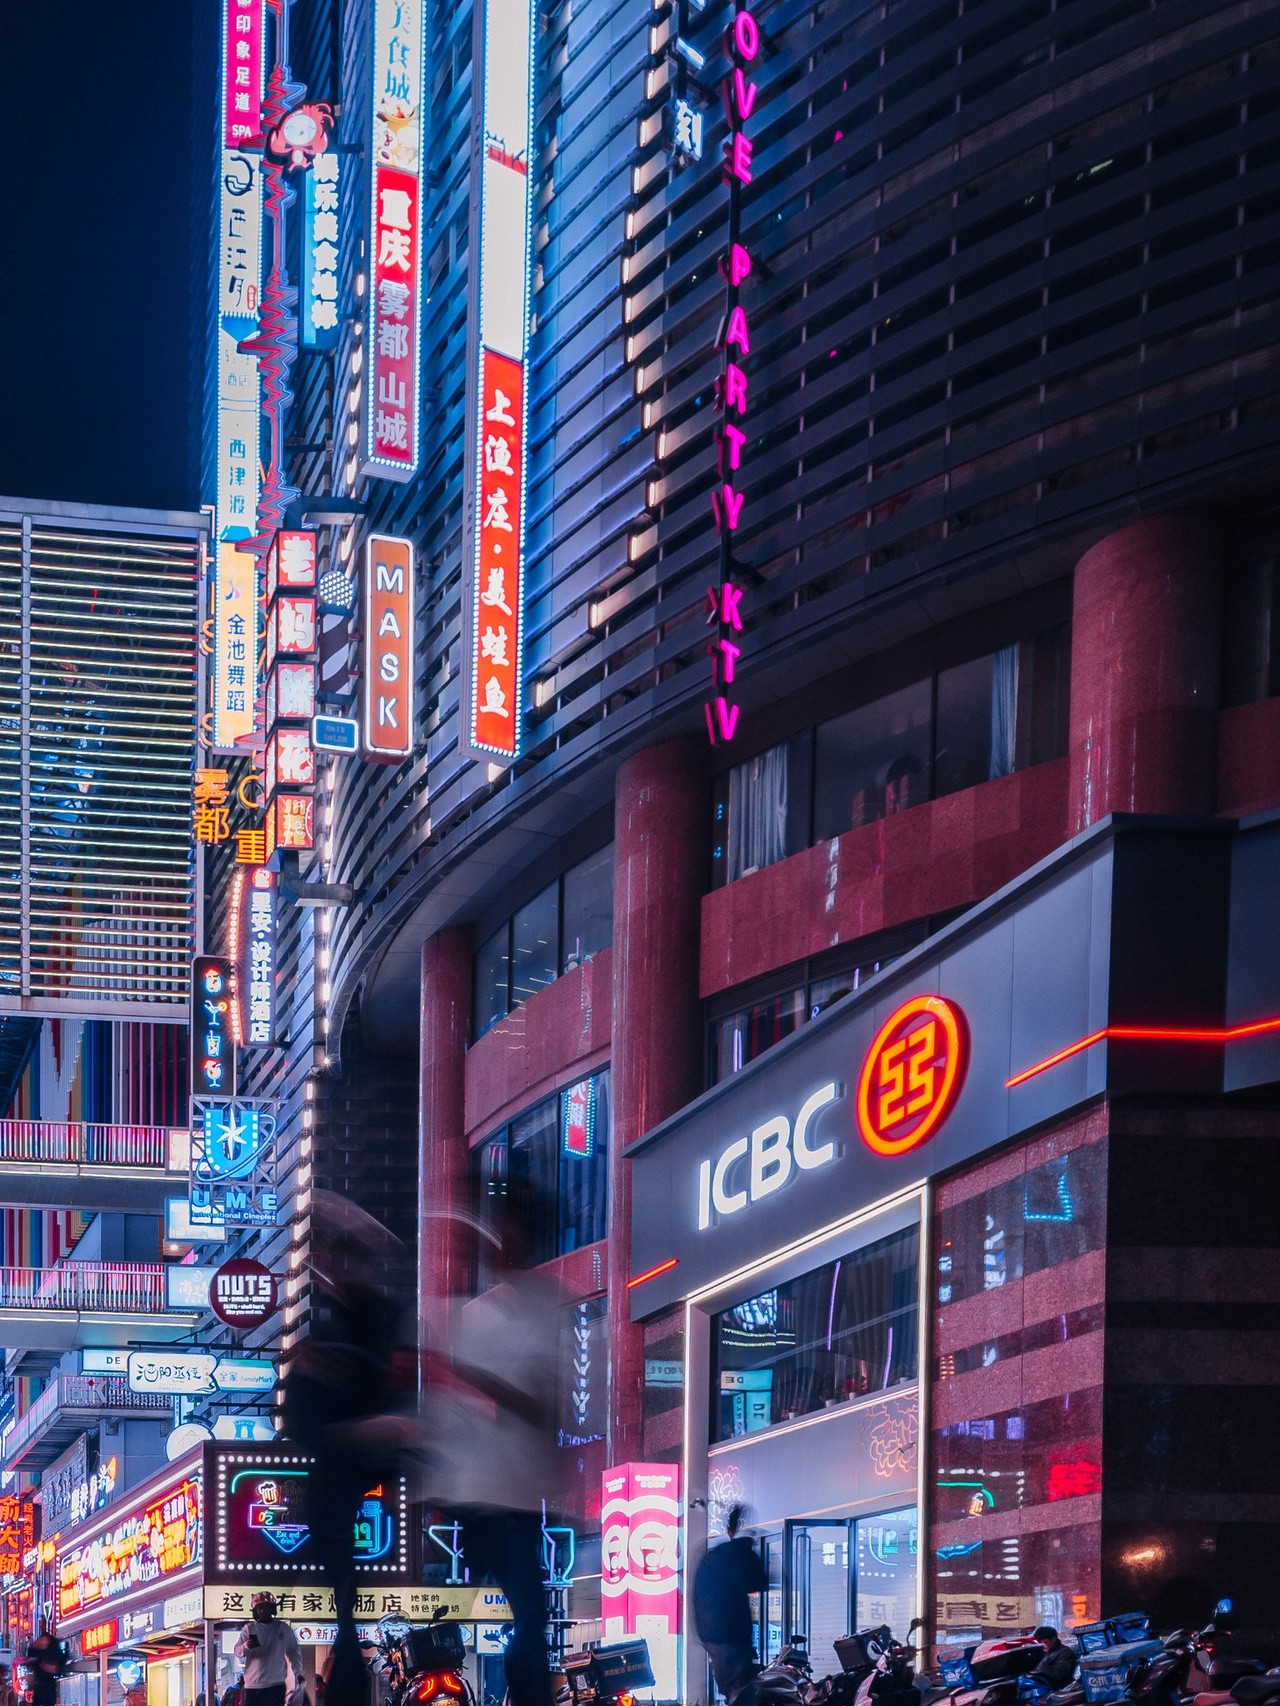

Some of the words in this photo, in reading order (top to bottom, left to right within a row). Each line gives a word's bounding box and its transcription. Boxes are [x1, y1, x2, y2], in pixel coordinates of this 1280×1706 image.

[733, 0, 759, 184] OVE
[232, 124, 252, 138] SPA
[723, 243, 751, 530] PARTY
[229, 438, 247, 514] 西津渡
[376, 565, 404, 729] MASK
[226, 614, 246, 712] 金池舞蹈
[715, 582, 743, 741] KTV
[698, 1083, 839, 1232] ICBC
[192, 1190, 278, 1210] UME
[243, 1212, 277, 1221] Cineplex
[217, 1275, 272, 1296] NUTS
[106, 1356, 121, 1365] DE
[220, 1371, 238, 1383] 全家
[223, 1592, 403, 1613] 这有家肠店
[410, 1593, 440, 1603] 她家的
